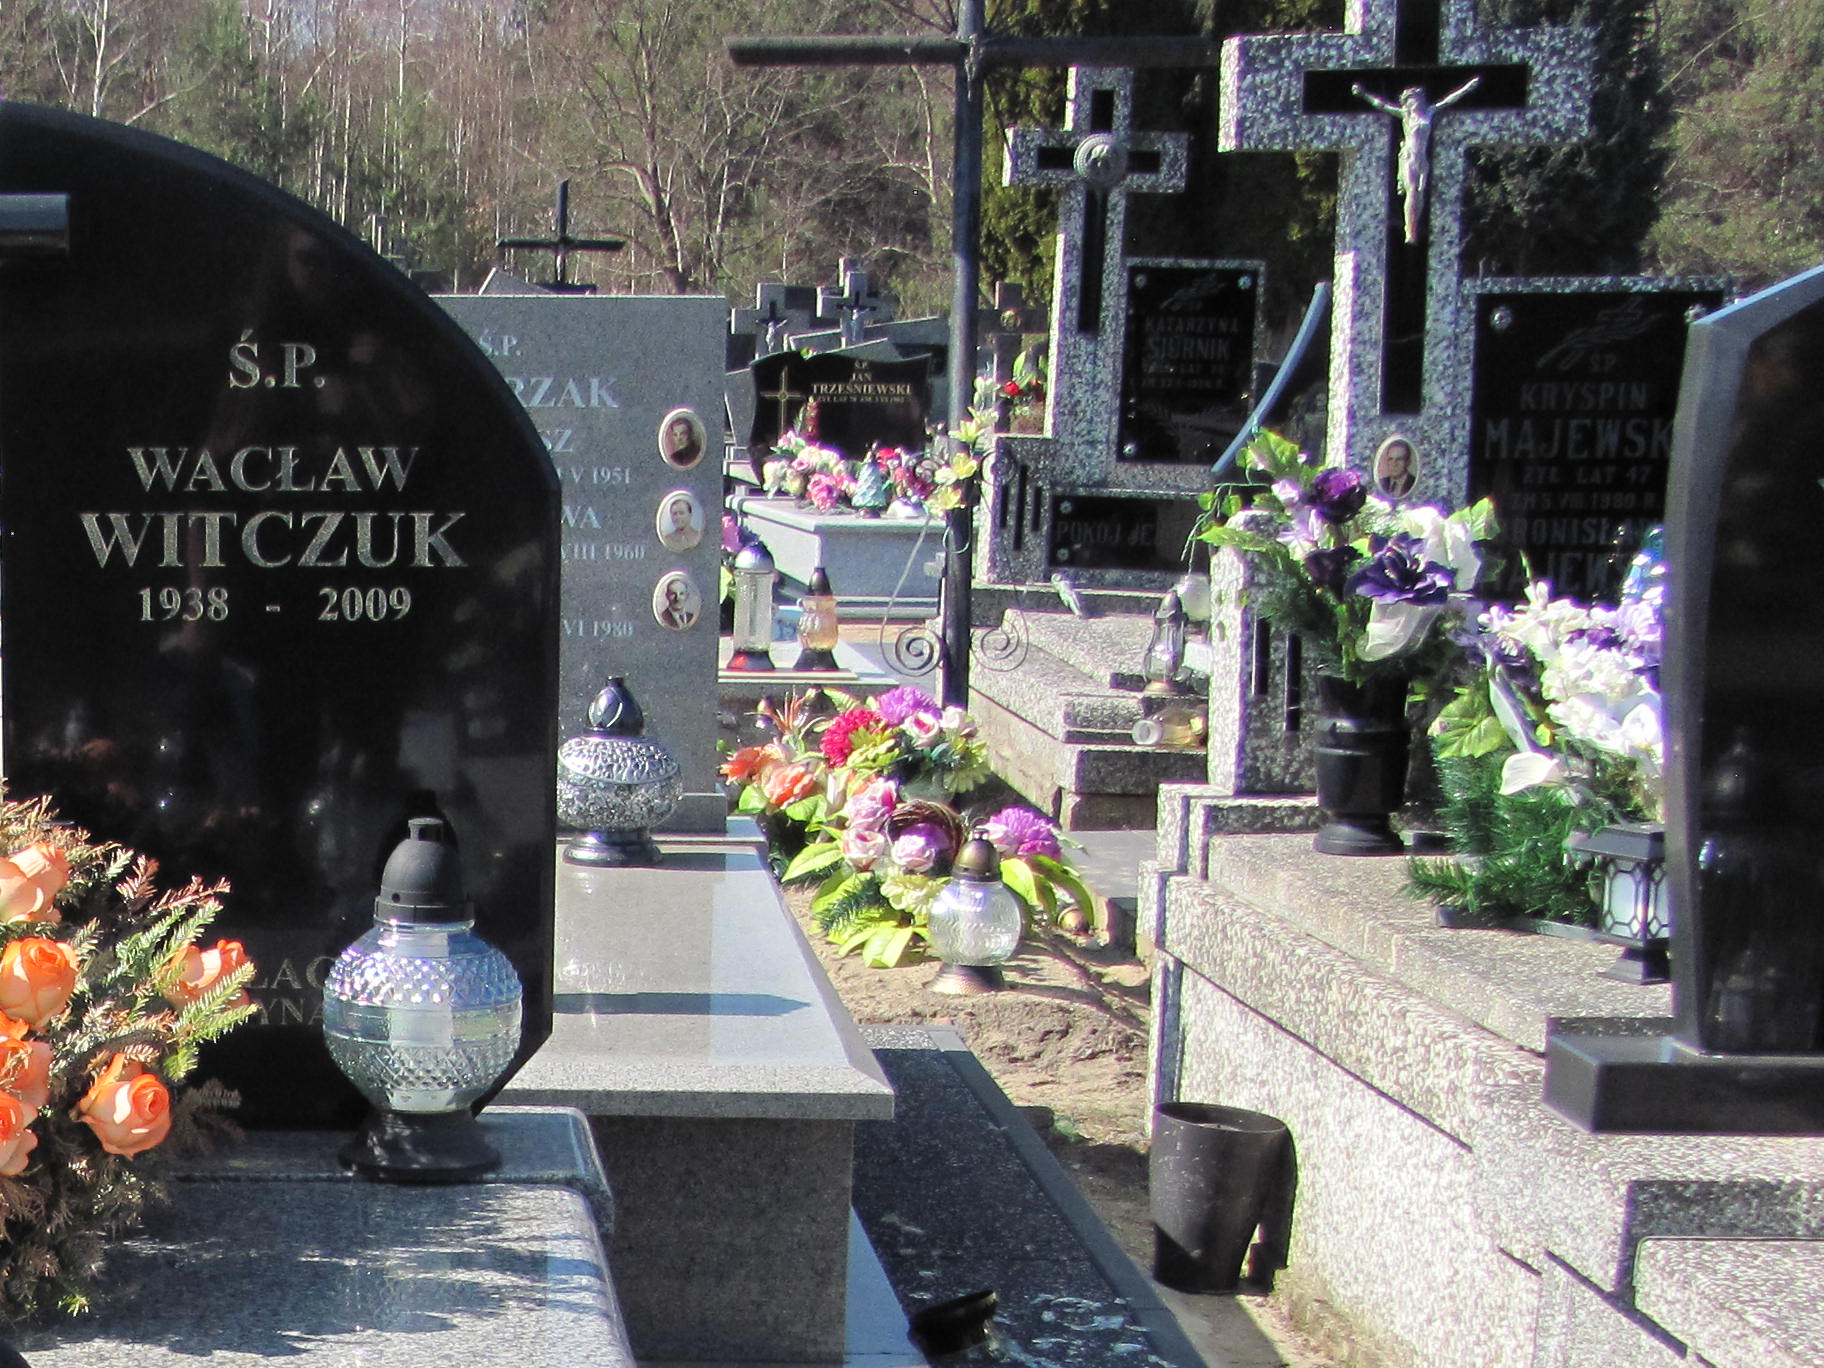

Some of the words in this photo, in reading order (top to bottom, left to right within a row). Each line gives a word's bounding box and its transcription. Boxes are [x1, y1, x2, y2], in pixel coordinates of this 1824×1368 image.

[228, 330, 325, 388] Ś.P.
[1520, 383, 1646, 411] KRYSPIN
[127, 445, 419, 492] WACŁAW
[592, 467, 632, 485] 1951
[80, 511, 469, 569] WITCZUK
[138, 587, 229, 621] 1938
[318, 586, 412, 621] 2009
[591, 620, 634, 642] 1980
